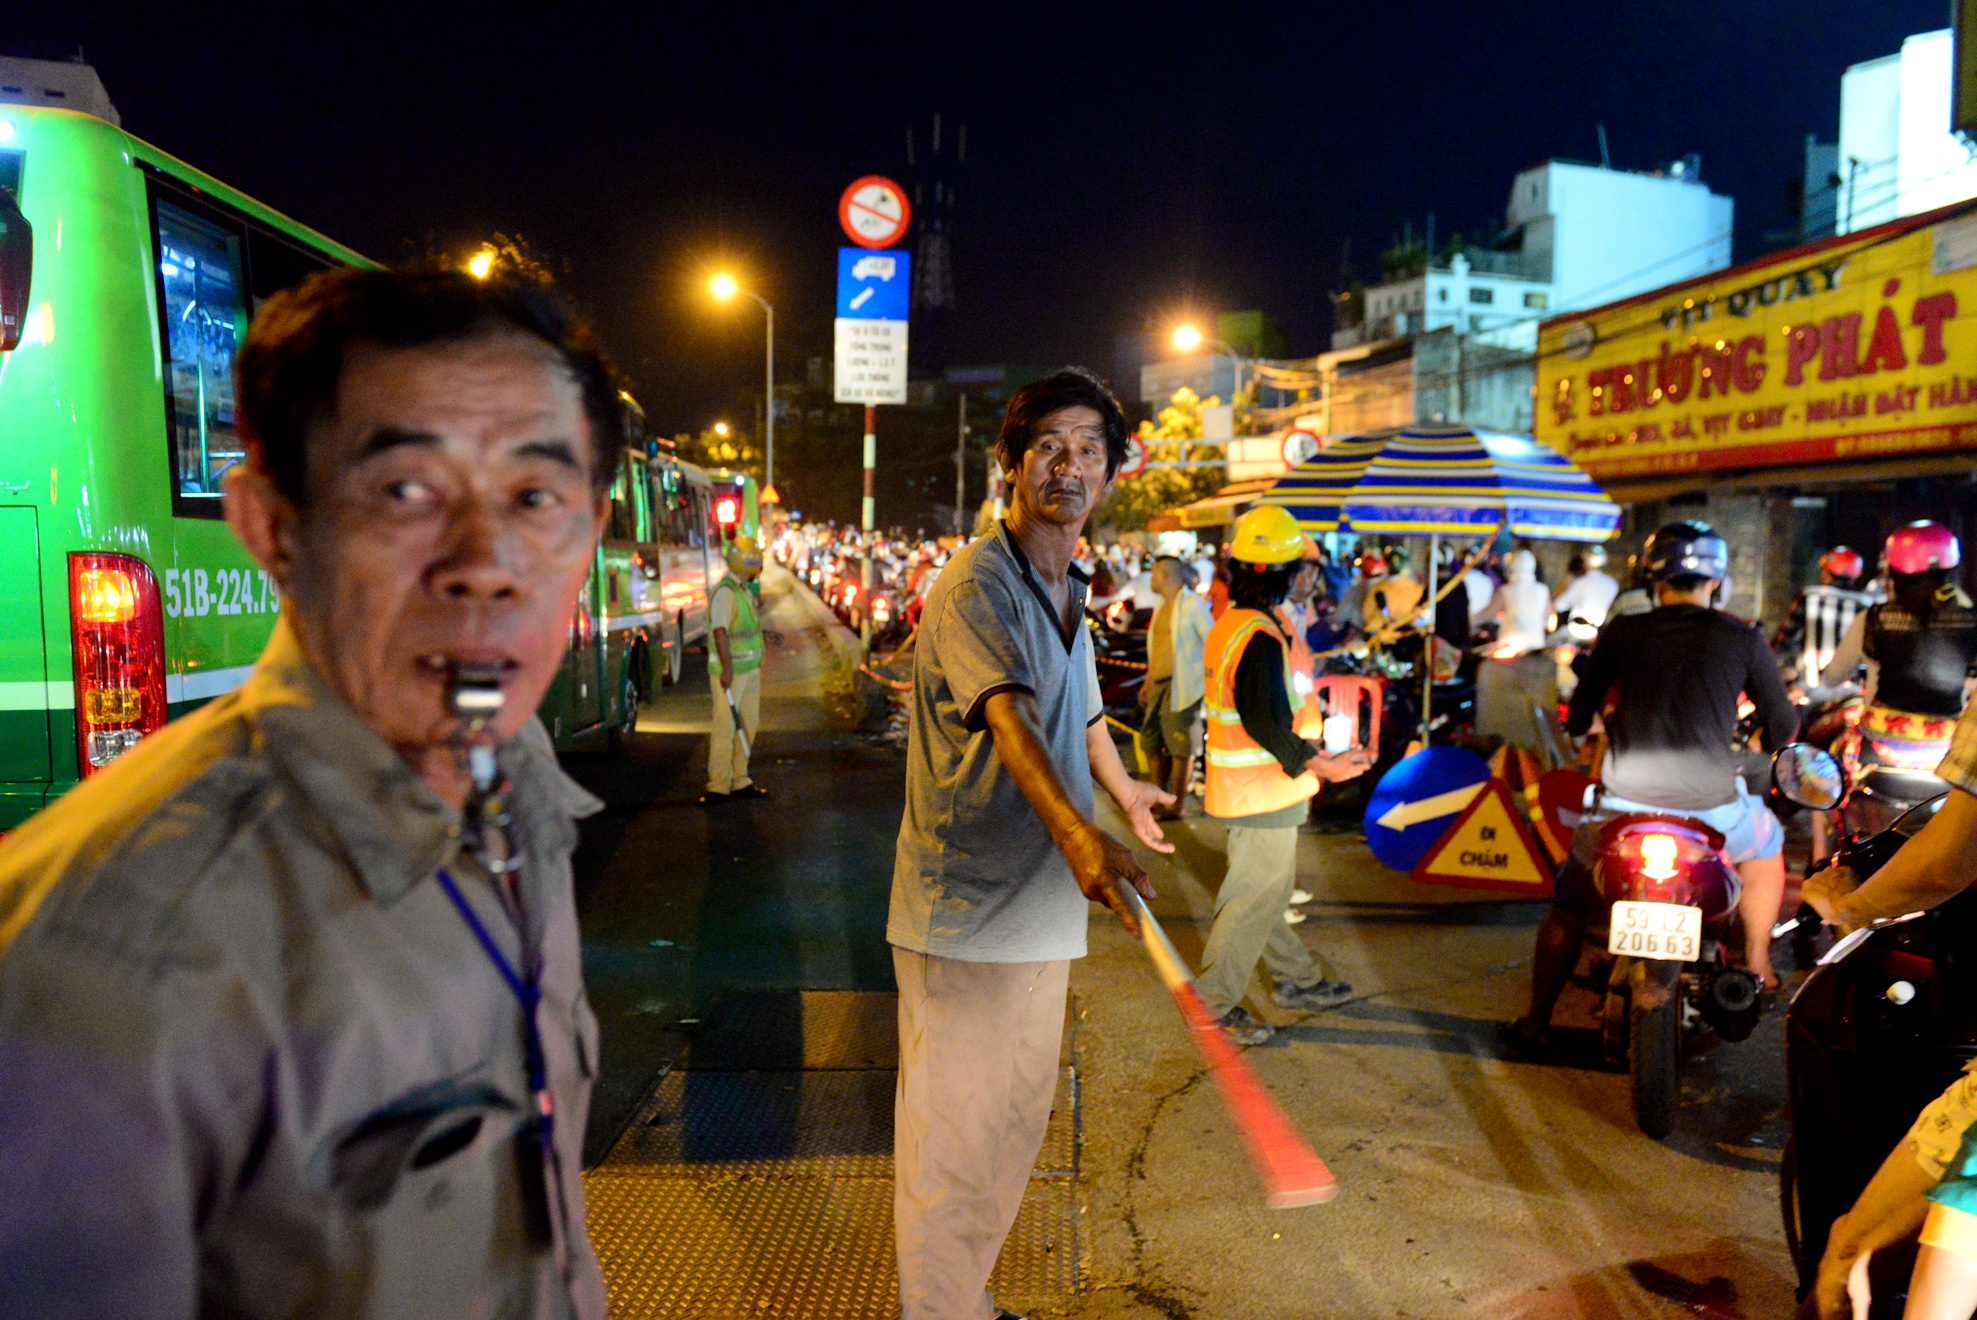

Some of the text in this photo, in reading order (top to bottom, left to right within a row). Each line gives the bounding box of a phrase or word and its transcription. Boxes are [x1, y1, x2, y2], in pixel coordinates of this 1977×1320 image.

[1726, 263, 1848, 317] QUAY
[1784, 277, 1958, 386] PHÁT
[165, 569, 280, 618] 51B-224.79
